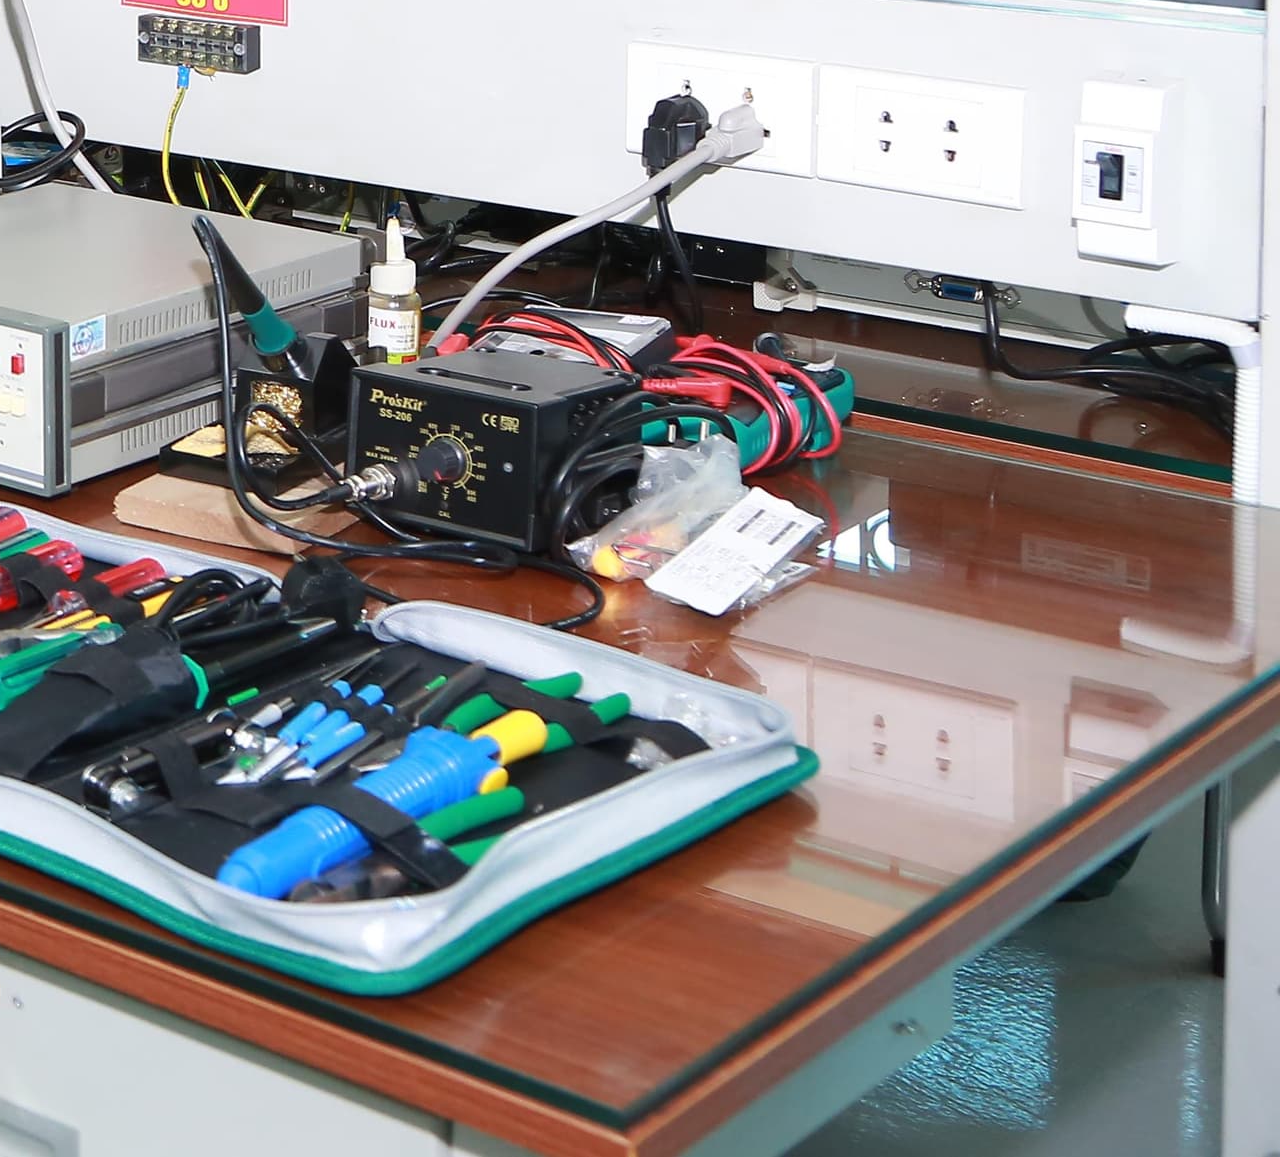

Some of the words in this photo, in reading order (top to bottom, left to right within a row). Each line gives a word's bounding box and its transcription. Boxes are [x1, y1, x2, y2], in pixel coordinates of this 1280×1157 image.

[370, 316, 396, 329] FLUX
[379, 408, 412, 422] SS-206
[438, 510, 451, 519] CAL
